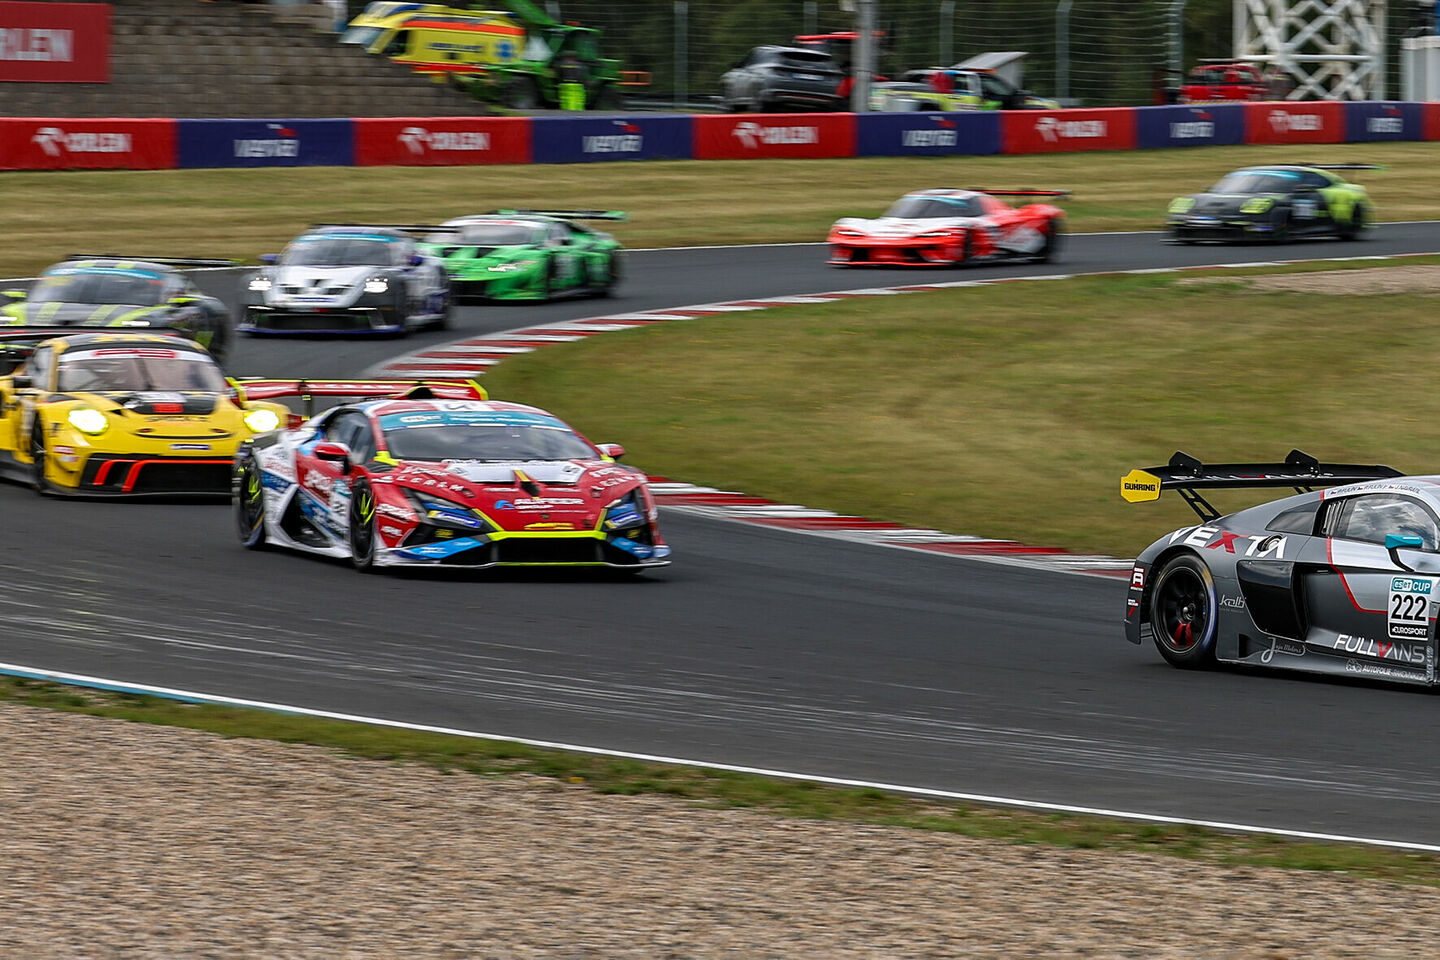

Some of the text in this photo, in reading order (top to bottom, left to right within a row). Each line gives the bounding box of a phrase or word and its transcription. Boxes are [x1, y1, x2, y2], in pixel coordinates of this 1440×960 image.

[66, 133, 132, 152] ORLEN
[428, 132, 491, 151] ORLEN
[1169, 526, 1288, 559] VEXTA
[1393, 580, 1431, 592] eset CUP
[1391, 594, 1427, 622] 222
[1392, 627, 1427, 636] EUROSPORT
[1333, 633, 1425, 663] FULLVANS
